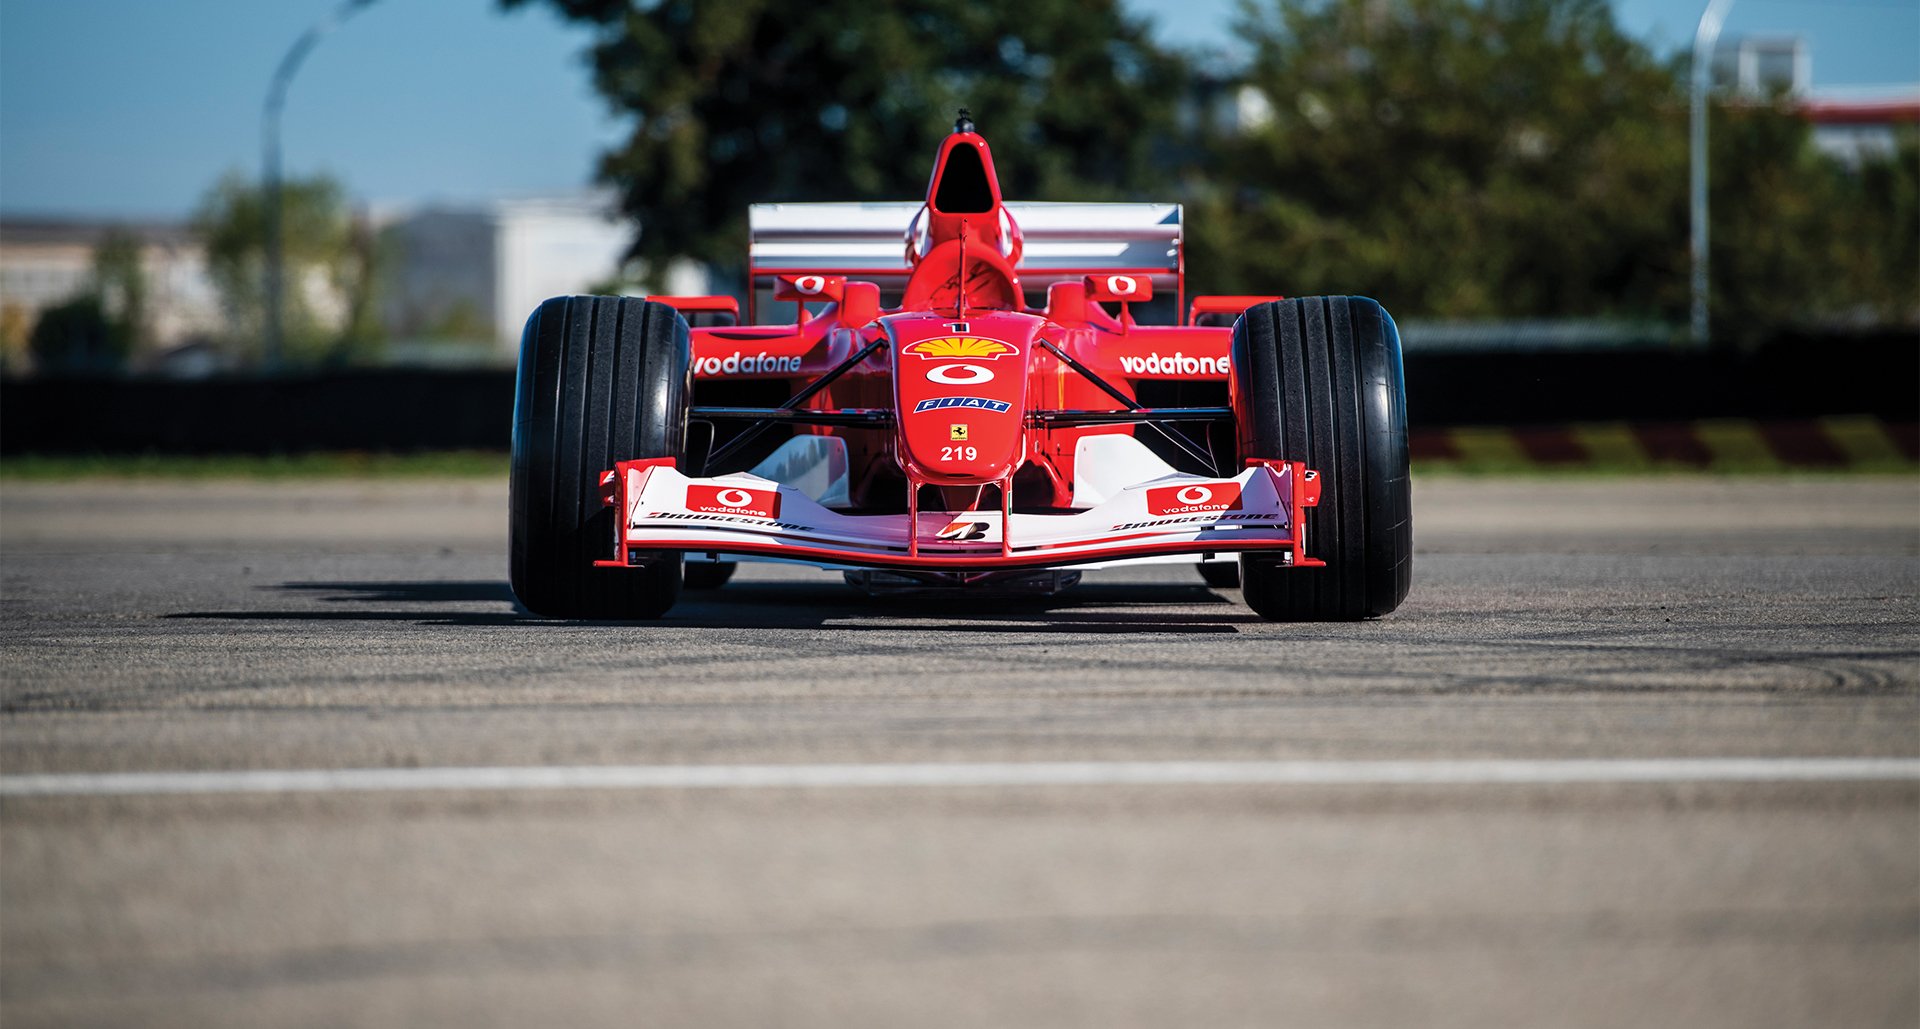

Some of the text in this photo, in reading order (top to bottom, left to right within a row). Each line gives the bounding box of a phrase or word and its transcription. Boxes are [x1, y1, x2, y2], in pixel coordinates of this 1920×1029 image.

[1119, 351, 1231, 375] vodafone
[921, 398, 1006, 410] FIAT
[941, 446, 977, 461] 219
[700, 506, 767, 517] vodafone
[1163, 504, 1230, 514] vodafone
[645, 512, 816, 532] BRIDGESTONE
[1109, 513, 1279, 531] BRIDGESTONE
